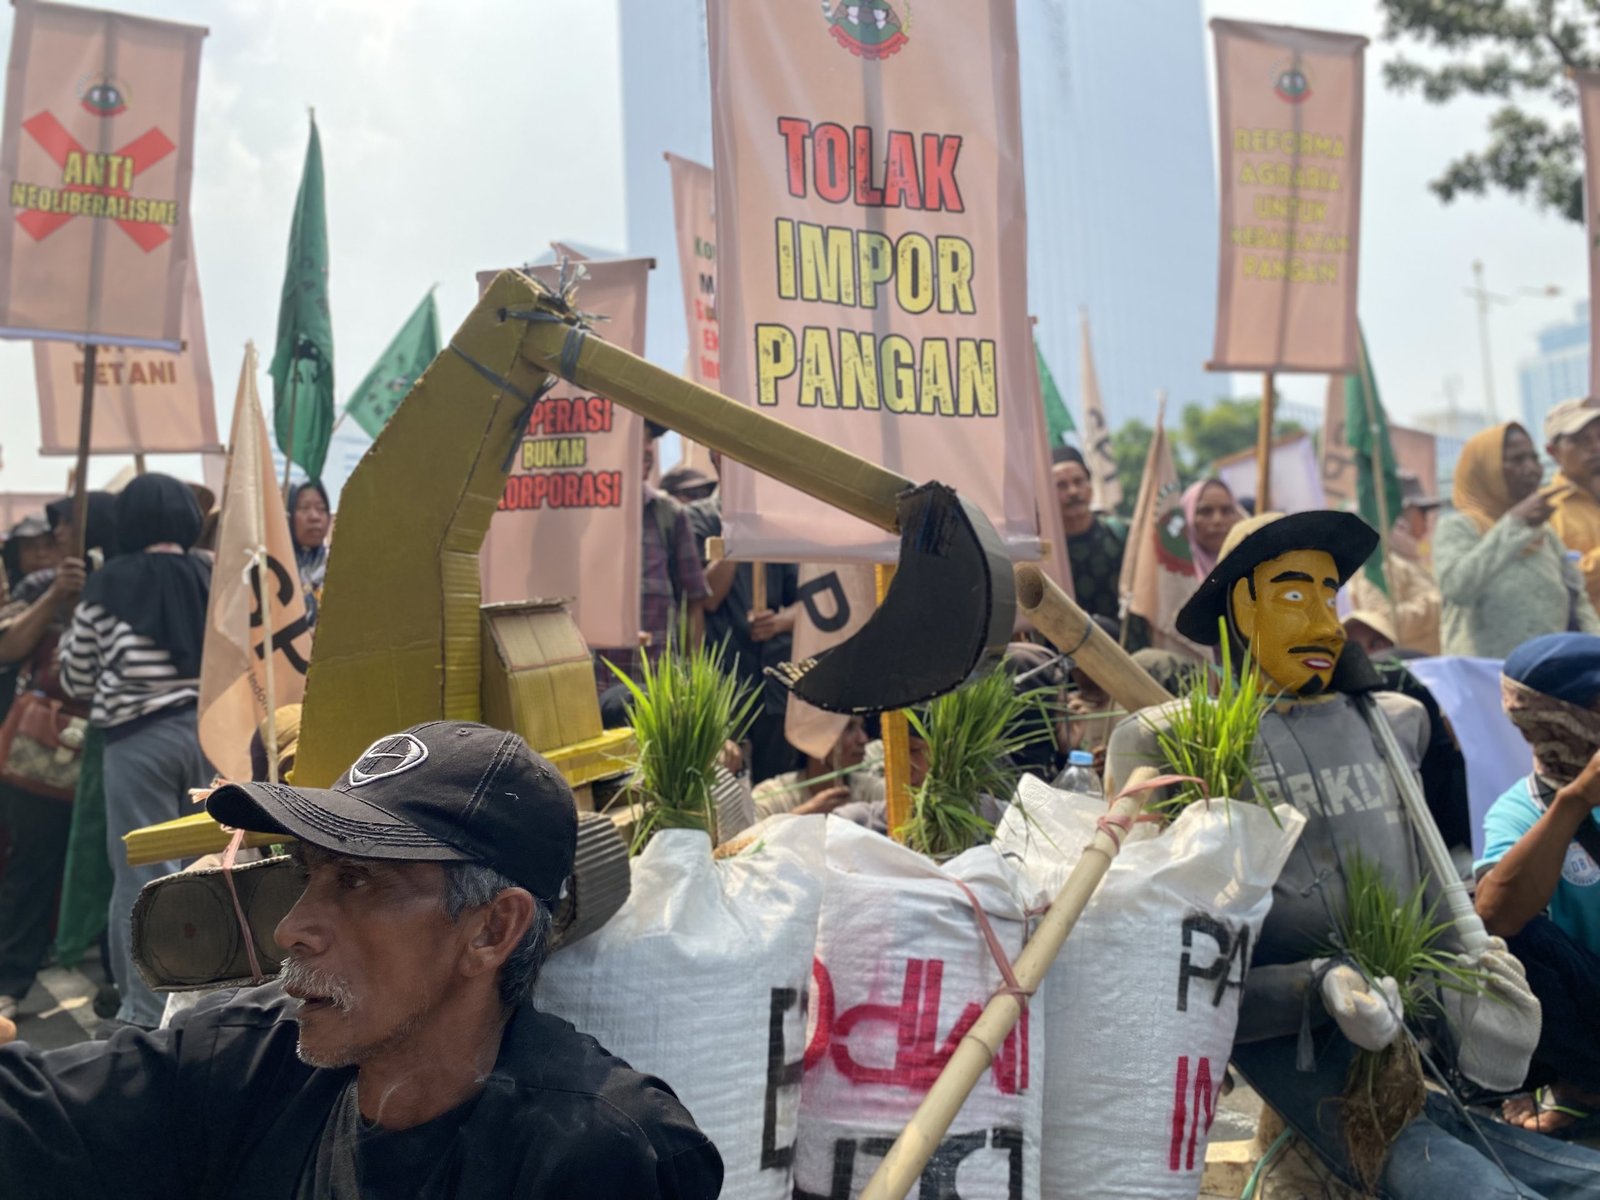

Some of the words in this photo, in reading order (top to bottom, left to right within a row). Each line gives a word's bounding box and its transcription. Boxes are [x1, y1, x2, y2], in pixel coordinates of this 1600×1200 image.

[1233, 127, 1346, 158] REFORMA
[62, 150, 136, 192] ANTI
[777, 116, 966, 213] TOLAK
[1237, 161, 1342, 192] AGRARIA
[10, 181, 179, 226] NEOLIBERALISME
[774, 217, 977, 315] IMPOR
[754, 322, 1000, 418] PANGAN
[527, 396, 613, 435] PERASI
[522, 437, 586, 469] BUKAN
[497, 470, 622, 512] ORPORASI
